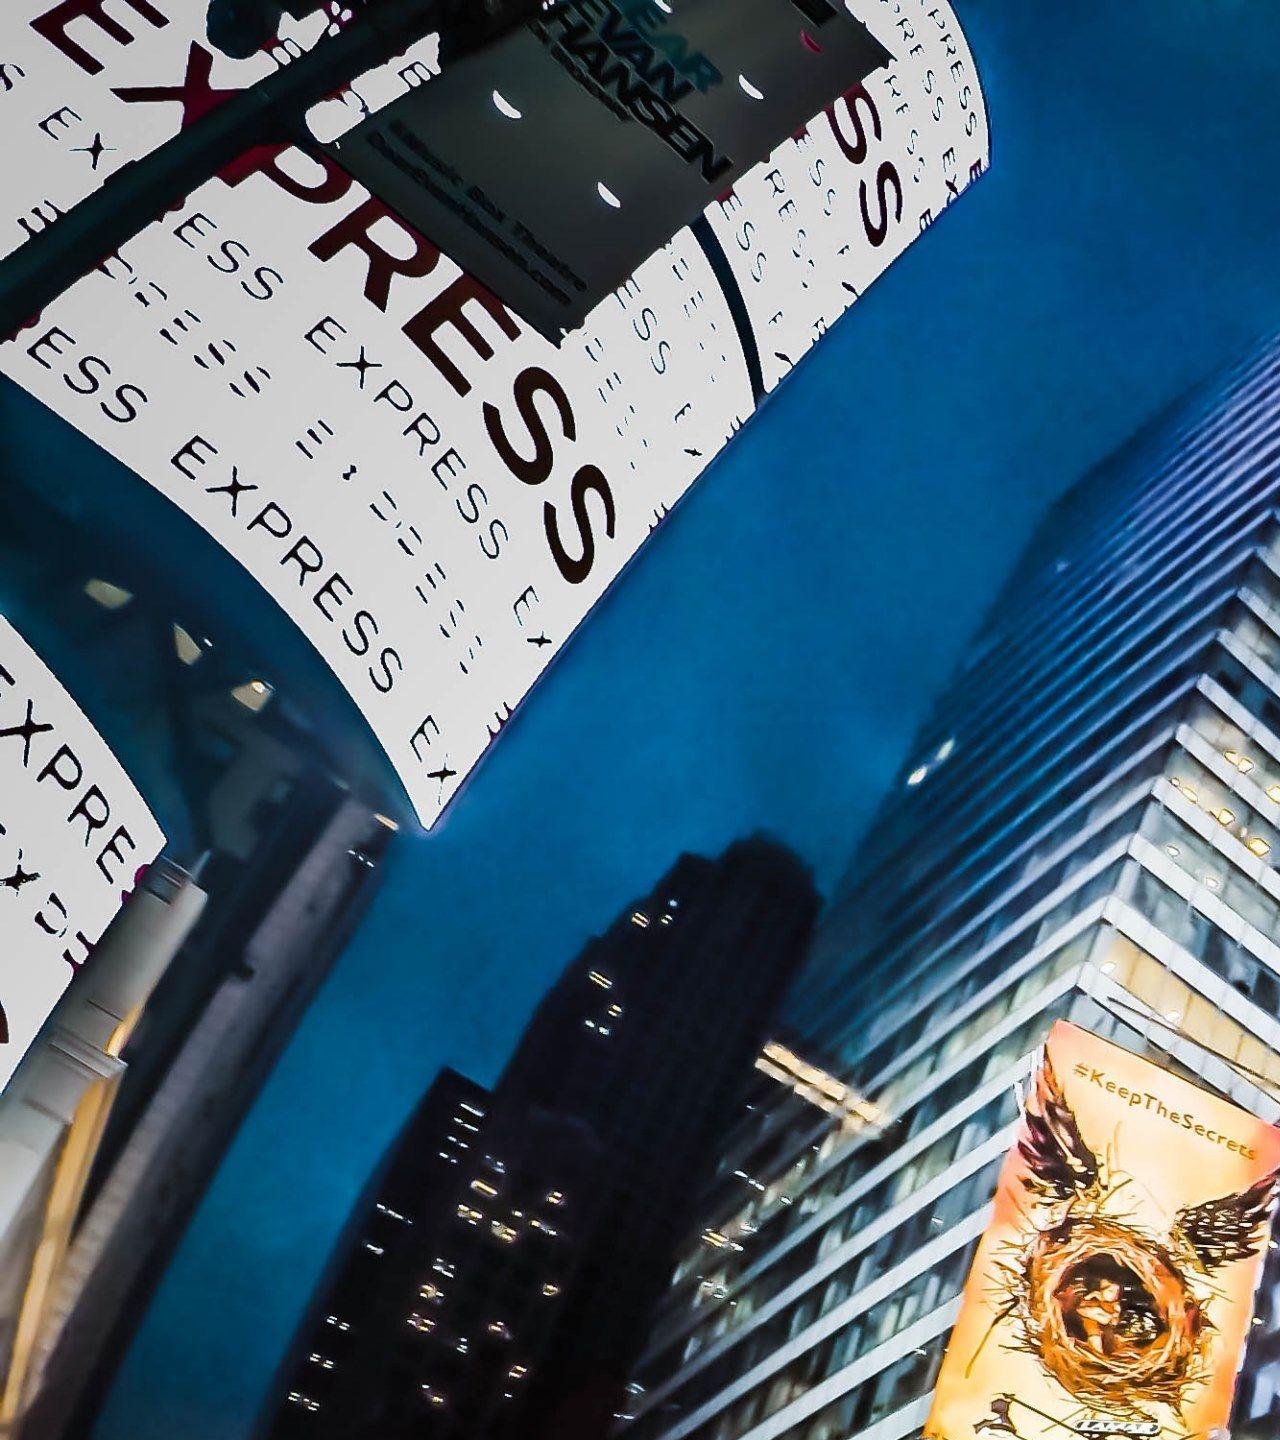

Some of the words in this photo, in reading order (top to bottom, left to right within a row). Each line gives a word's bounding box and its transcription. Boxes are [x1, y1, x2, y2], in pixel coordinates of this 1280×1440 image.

[550, 3, 733, 183] HANSEN
[303, 315, 509, 561] EXPRESS
[170, 436, 404, 693] EXPRESS
[1072, 1059, 1258, 1162] #KeepTheSecrets
